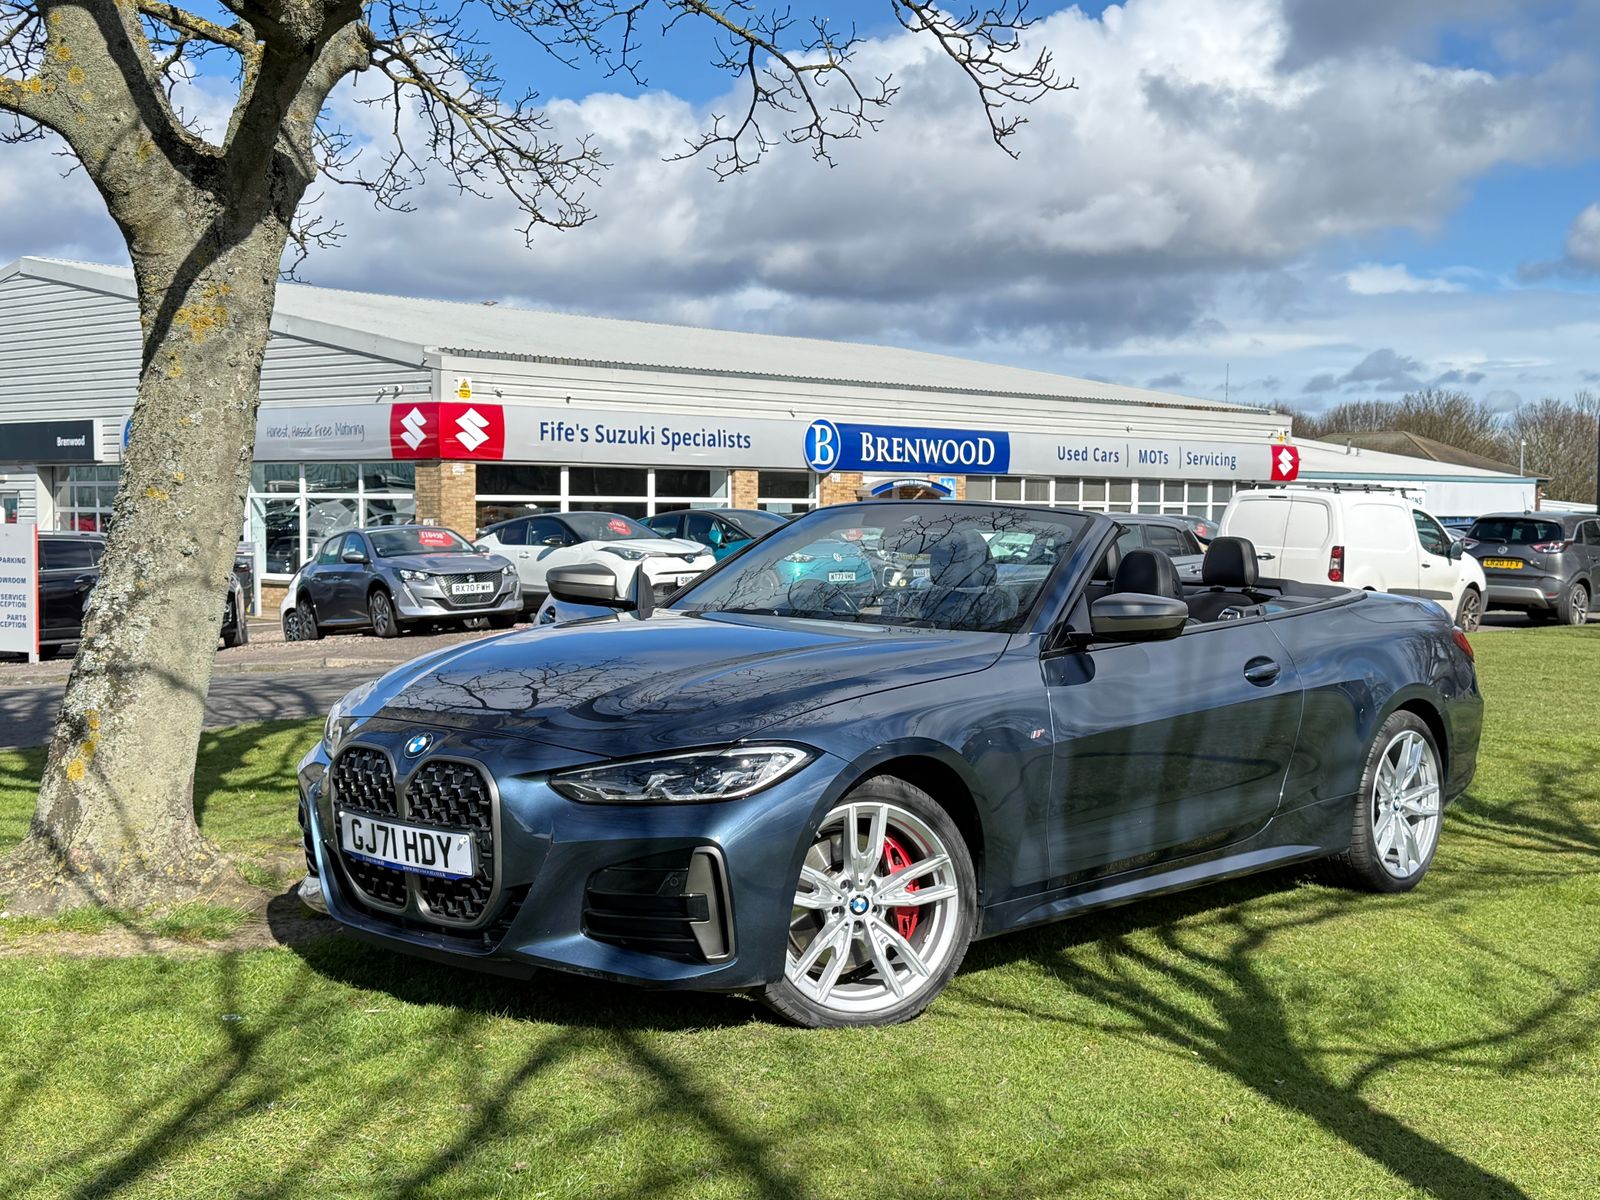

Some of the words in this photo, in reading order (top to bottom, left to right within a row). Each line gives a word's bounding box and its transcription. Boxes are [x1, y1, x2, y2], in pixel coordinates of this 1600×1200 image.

[314, 423, 333, 437] Free
[334, 421, 365, 442] Motoring
[539, 421, 589, 443] Fife's
[594, 424, 655, 445] Suzuki
[661, 427, 751, 451] Specialists
[811, 424, 834, 465] B
[860, 432, 995, 466] BRENWOOD
[1057, 445, 1088, 461] Used
[1093, 447, 1120, 463] Cars
[1138, 449, 1169, 465] MOTs
[1186, 451, 1237, 470] Servicing
[0, 593, 26, 601] SERVICE
[455, 584, 475, 593] RX70
[475, 583, 491, 591] FWH
[0, 621, 26, 629] CEPTION
[6, 613, 26, 621] PARTS
[351, 818, 398, 860] GJ71
[402, 829, 452, 869] HDY
